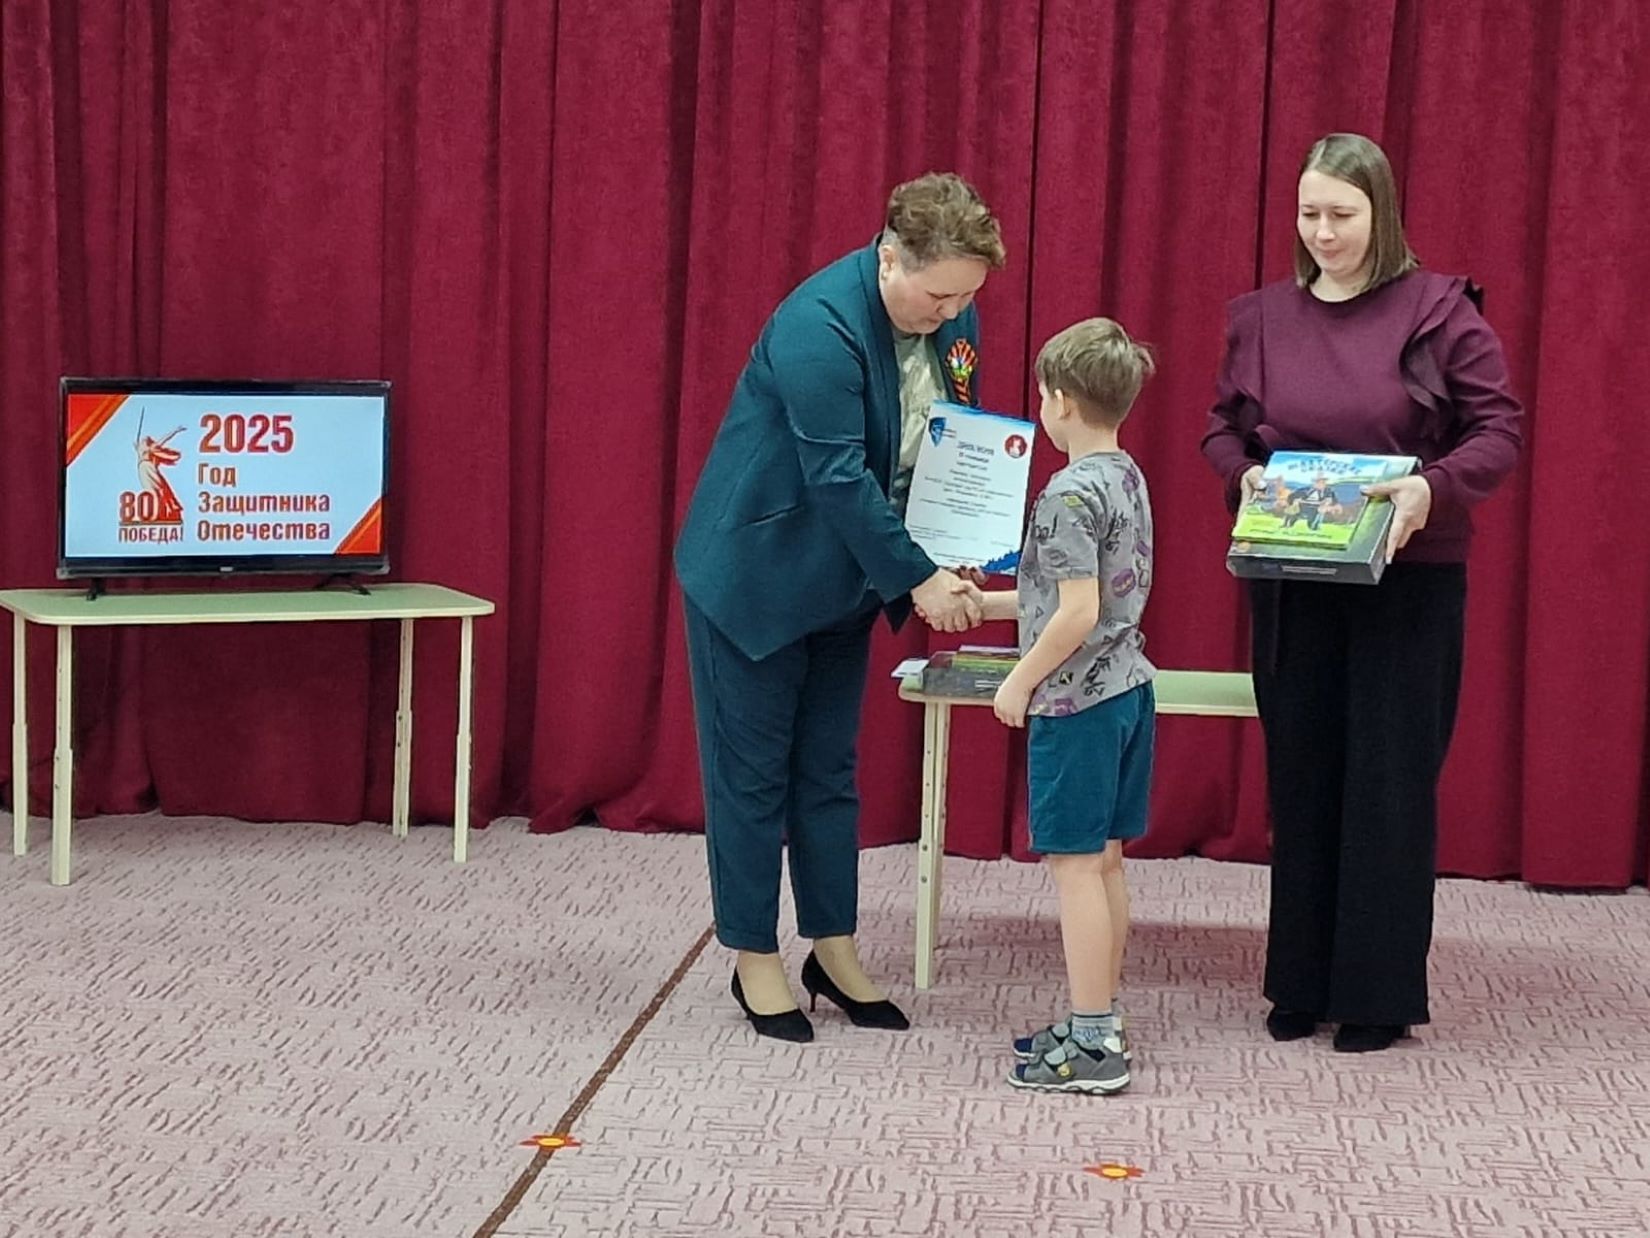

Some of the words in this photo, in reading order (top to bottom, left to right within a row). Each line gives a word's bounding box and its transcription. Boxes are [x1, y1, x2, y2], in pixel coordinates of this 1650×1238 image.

[200, 414, 294, 453] 2025
[198, 463, 236, 487] Год
[119, 491, 156, 522] 80
[198, 491, 330, 516] Защитника
[118, 527, 184, 544] ПОБЕДА!
[197, 520, 330, 541] Отечества
